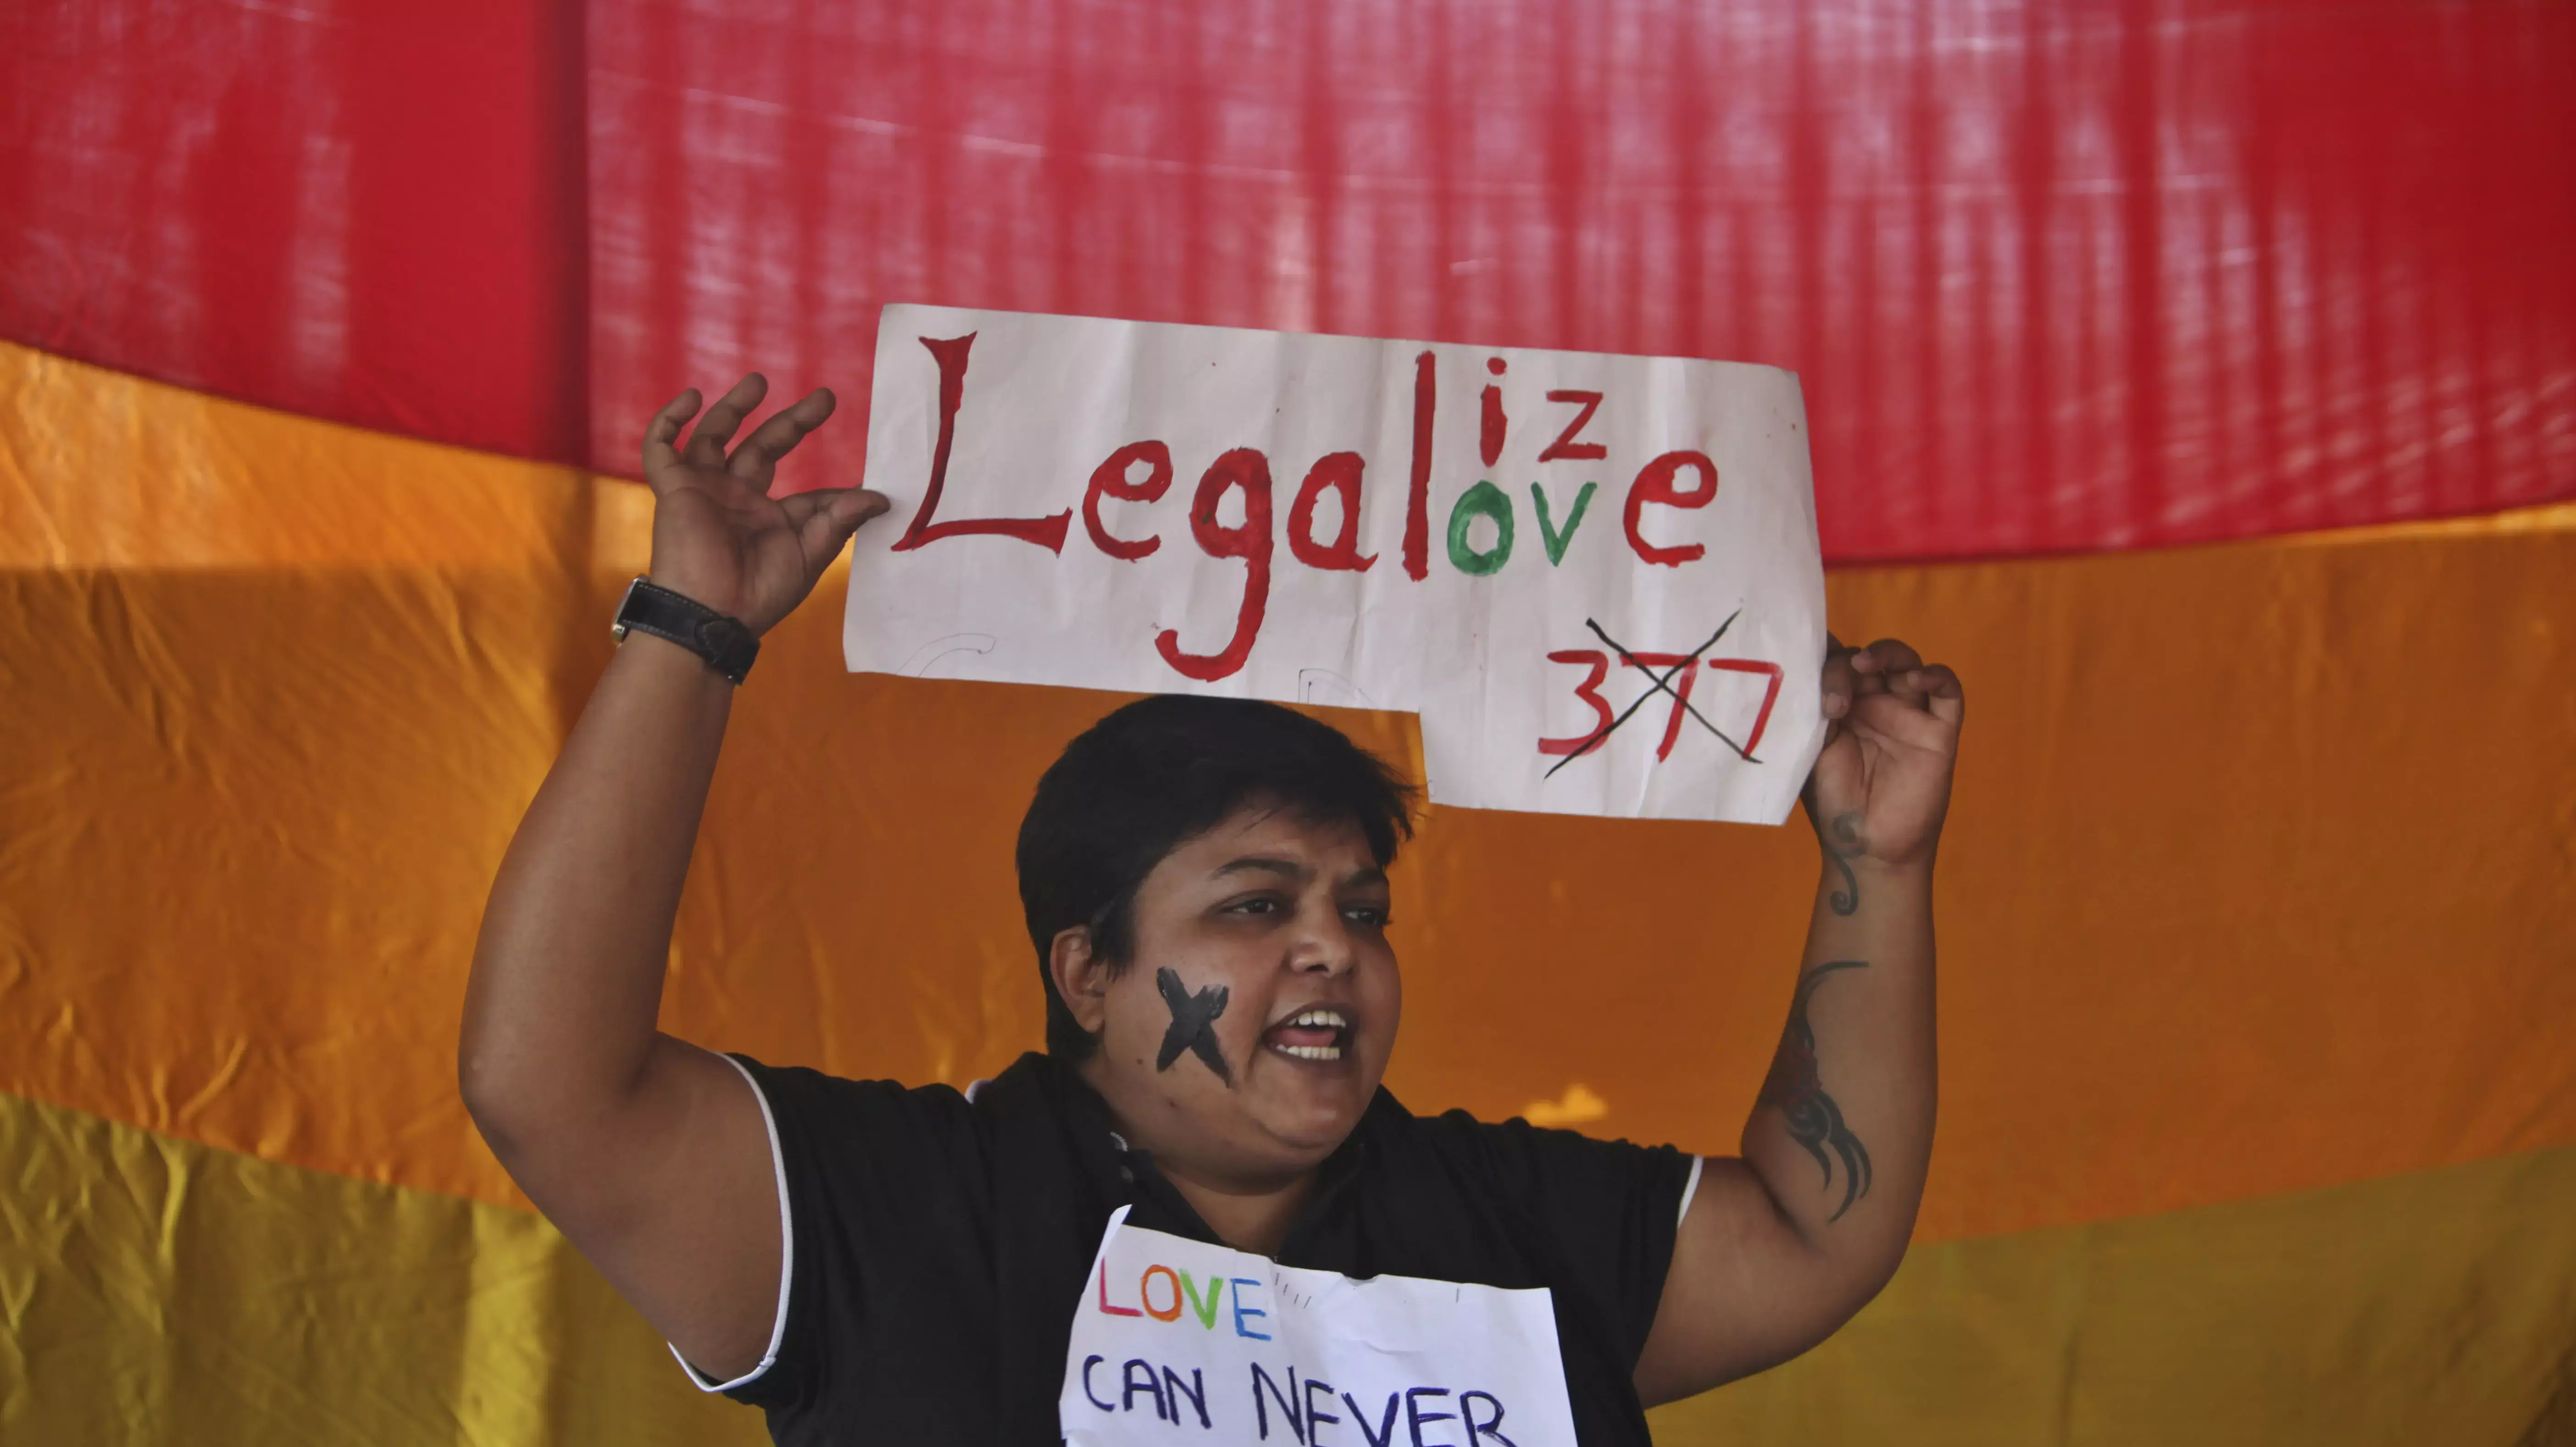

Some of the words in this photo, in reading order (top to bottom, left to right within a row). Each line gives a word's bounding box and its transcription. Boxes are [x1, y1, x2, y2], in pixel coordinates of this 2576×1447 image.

[1537, 649, 1785, 763] 377
[1100, 1255, 1272, 1342] LOVE
[1083, 1354, 1212, 1429] CAN
[1250, 1362, 1517, 1447] NEVER
